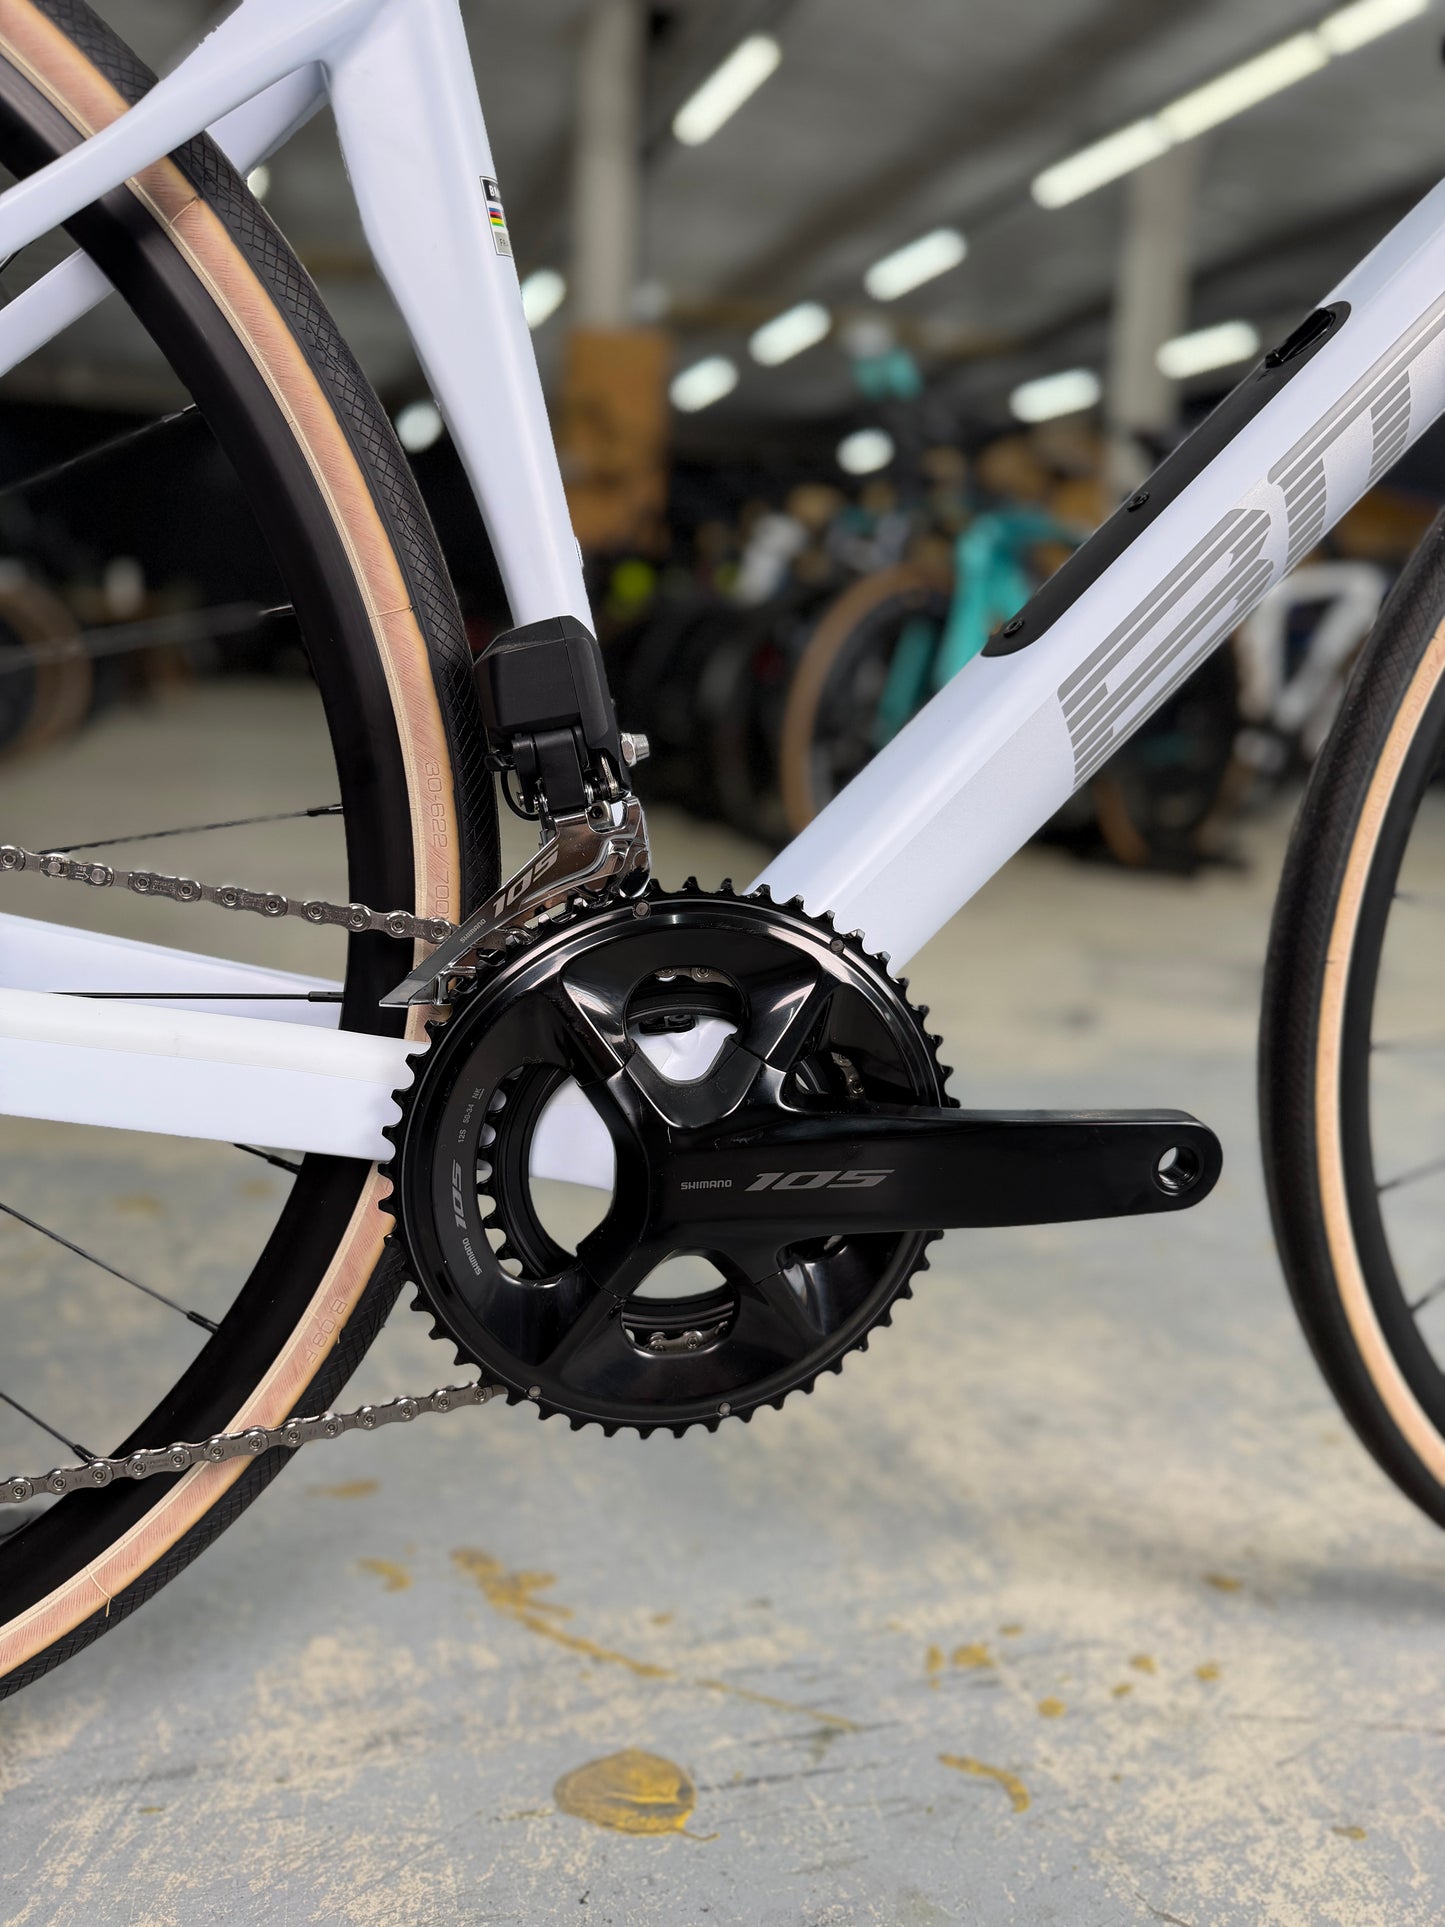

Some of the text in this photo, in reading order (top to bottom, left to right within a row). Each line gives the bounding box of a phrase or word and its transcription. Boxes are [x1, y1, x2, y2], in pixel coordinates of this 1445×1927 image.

[424, 762, 447, 848] 30-622
[435, 870, 450, 921] 700
[493, 844, 559, 918] 105
[459, 918, 487, 943] SHIMANO
[680, 1169, 896, 1192] SHIMANO 105
[452, 1159, 482, 1276] SHIMANO 105
